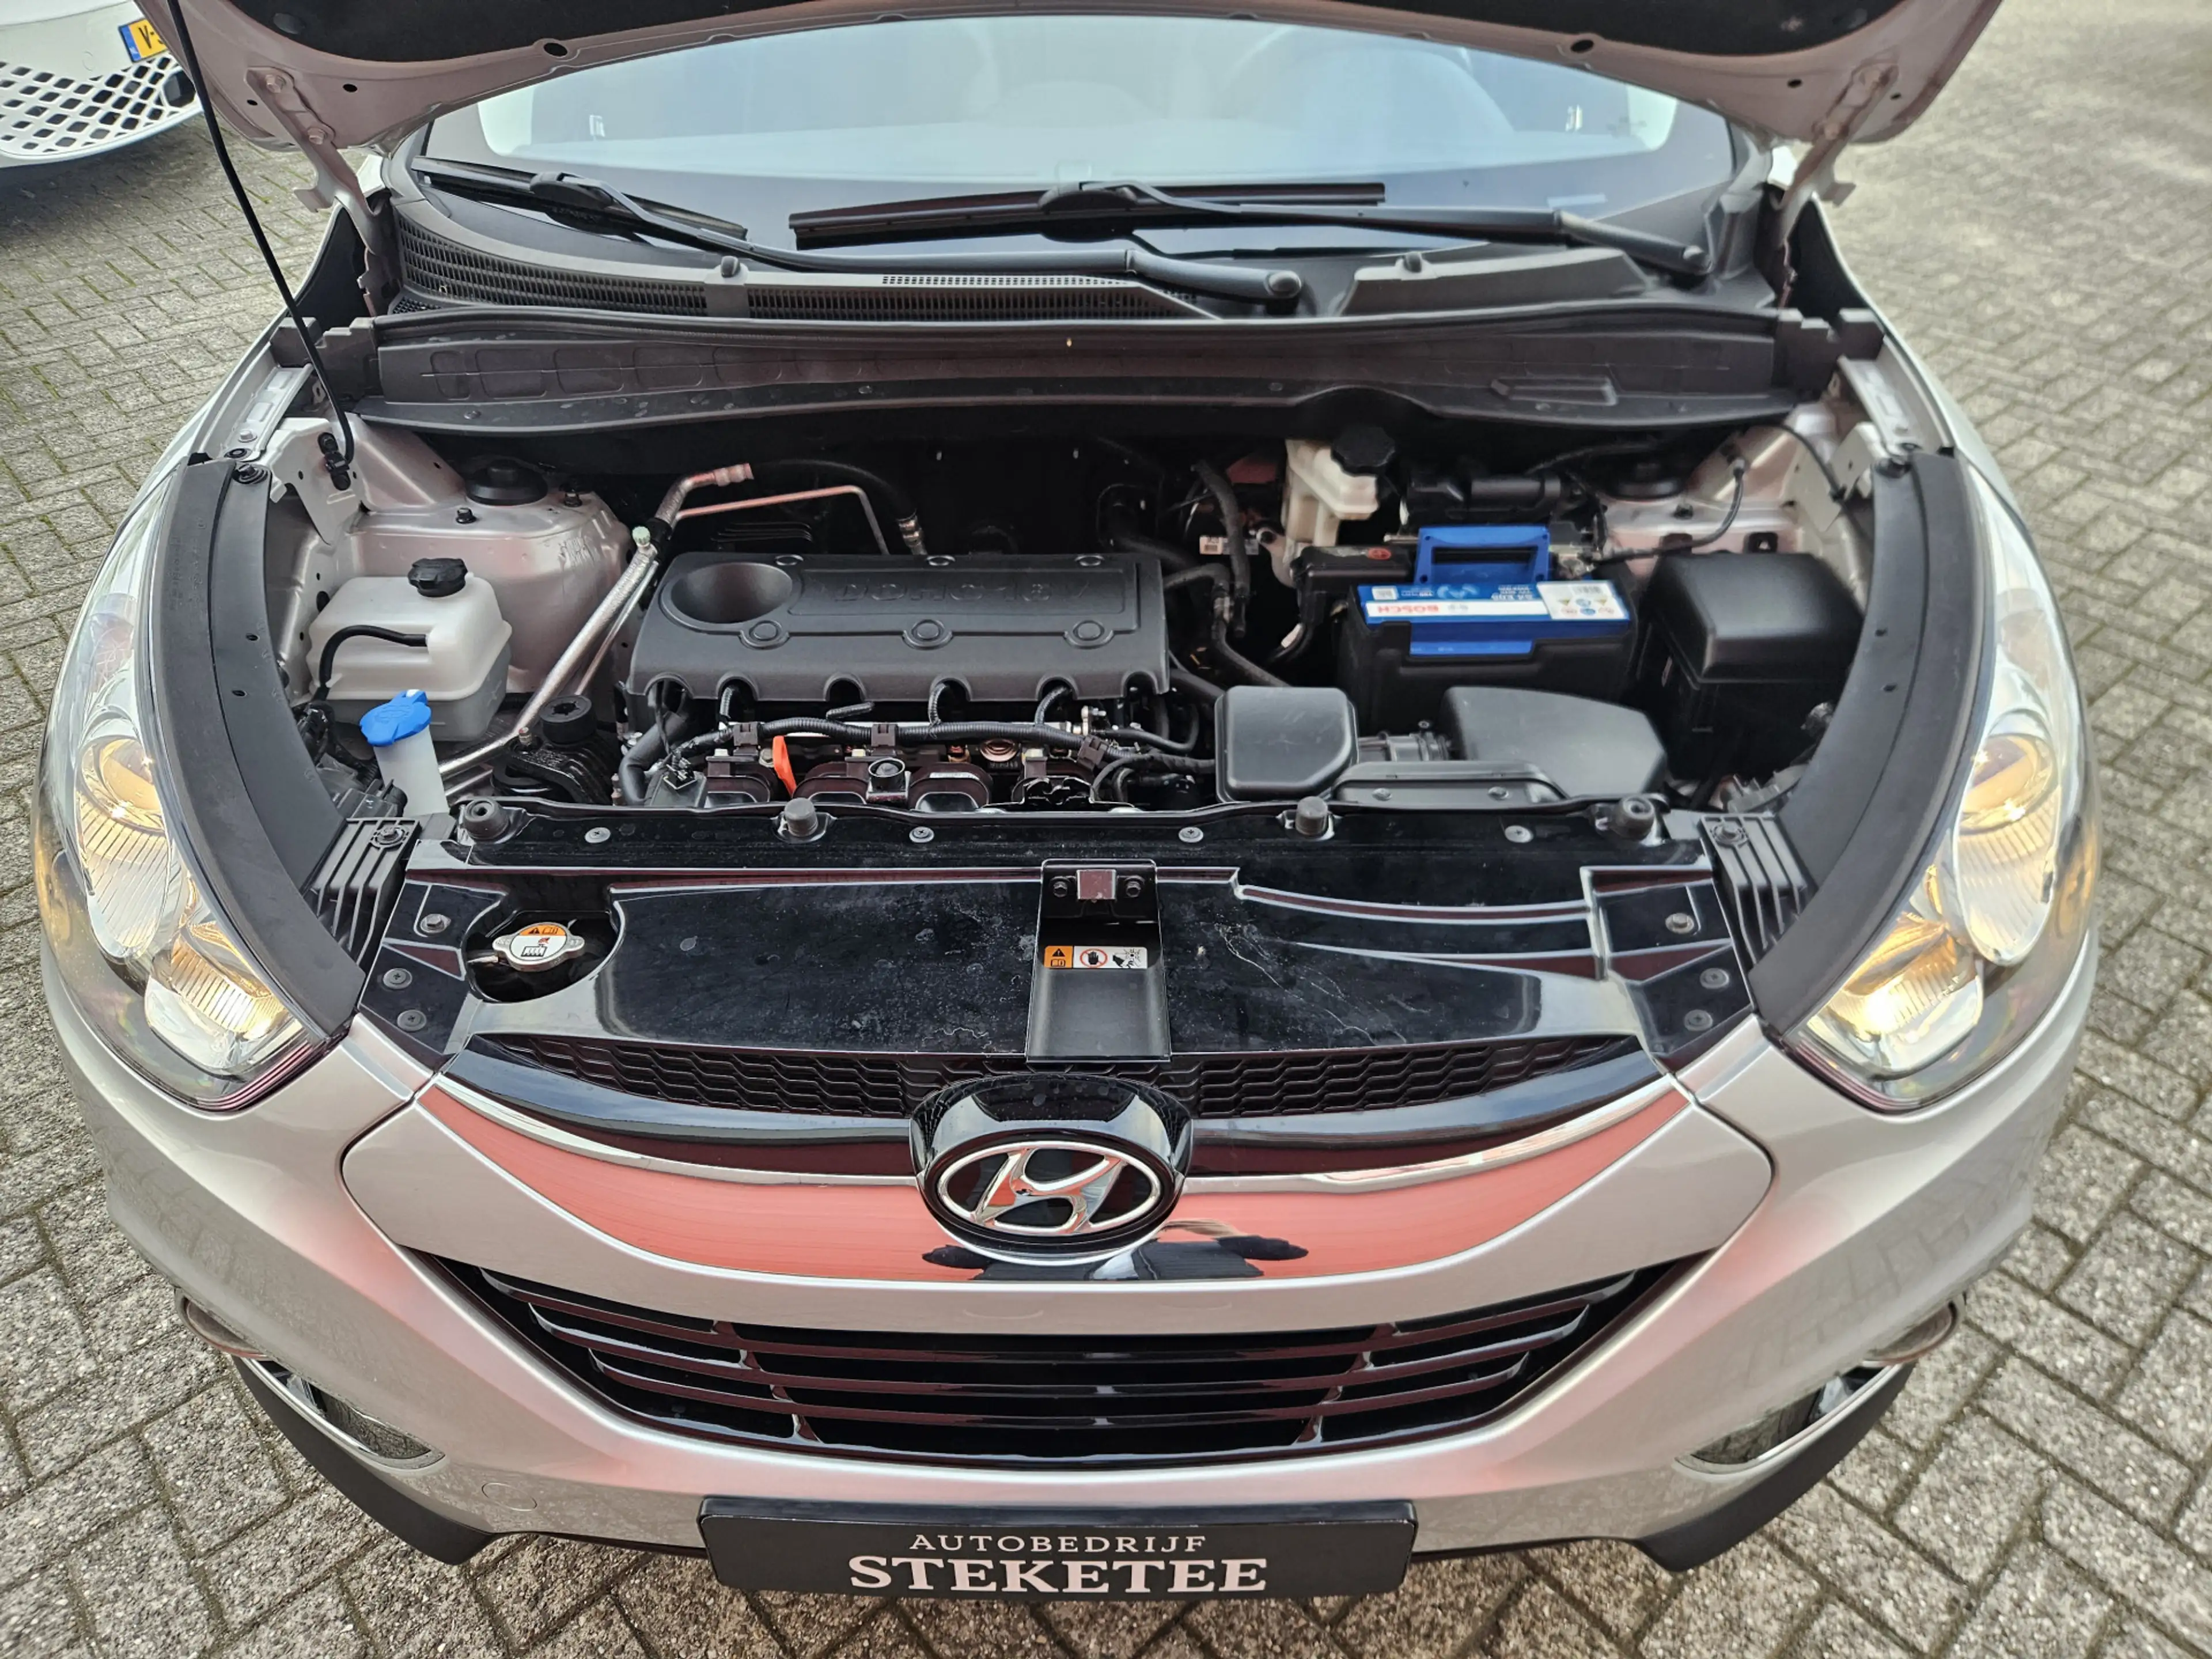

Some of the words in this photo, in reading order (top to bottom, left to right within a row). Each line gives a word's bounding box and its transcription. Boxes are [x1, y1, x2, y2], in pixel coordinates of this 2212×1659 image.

[1377, 604, 1439, 613] BOSCH
[909, 1534, 1206, 1553] AUTOBEDRIJF
[849, 1555, 1267, 1593] STEKETEE
